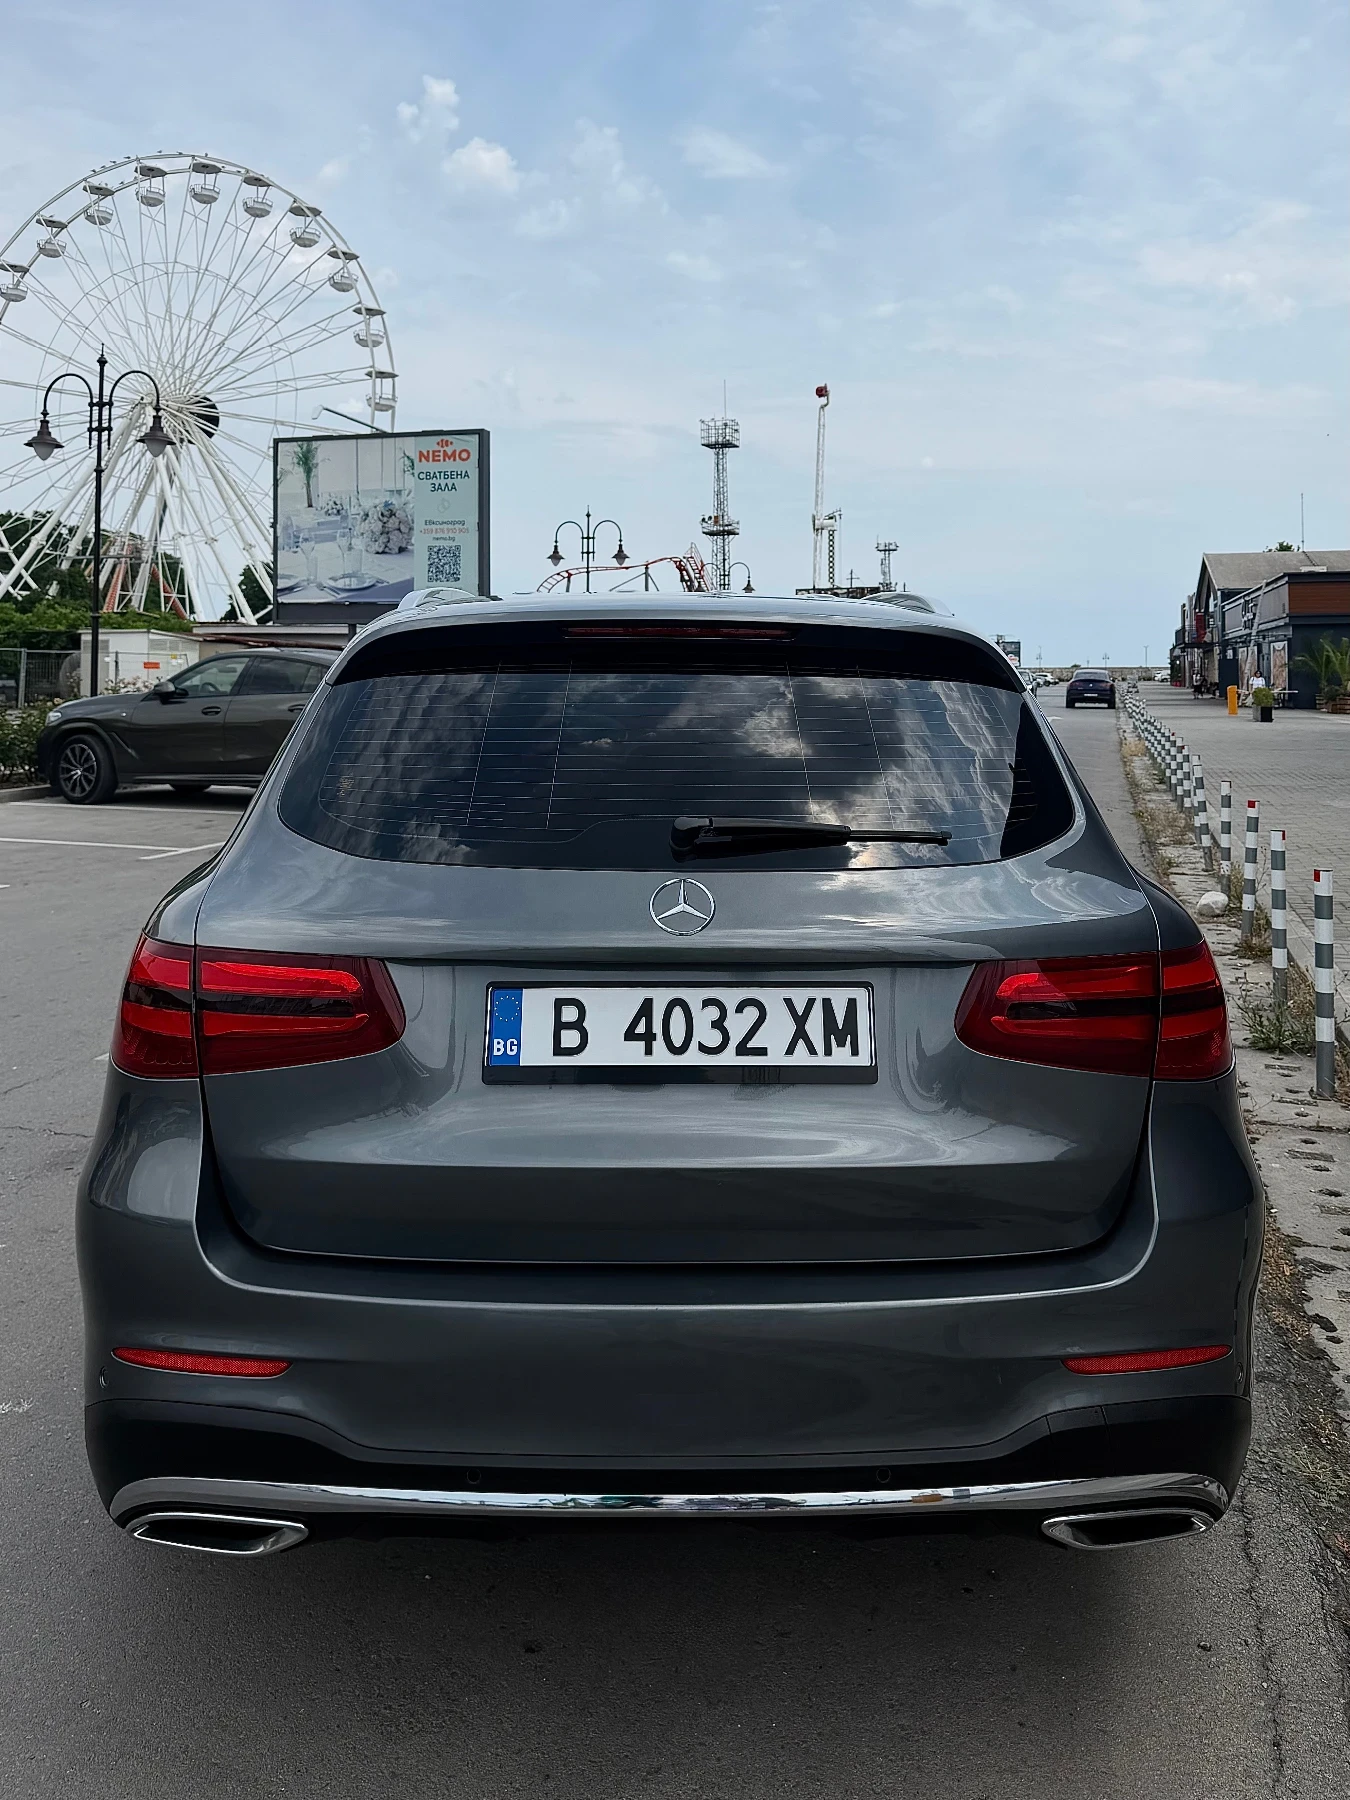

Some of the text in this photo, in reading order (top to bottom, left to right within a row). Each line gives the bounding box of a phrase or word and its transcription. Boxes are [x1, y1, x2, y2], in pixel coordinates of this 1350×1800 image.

[418, 448, 471, 463] NEMO
[417, 470, 470, 480] СВАТБЕНА
[430, 482, 457, 492] ЗАЛА
[552, 997, 860, 1057] B 4032 XM
[493, 1037, 518, 1056] BG
